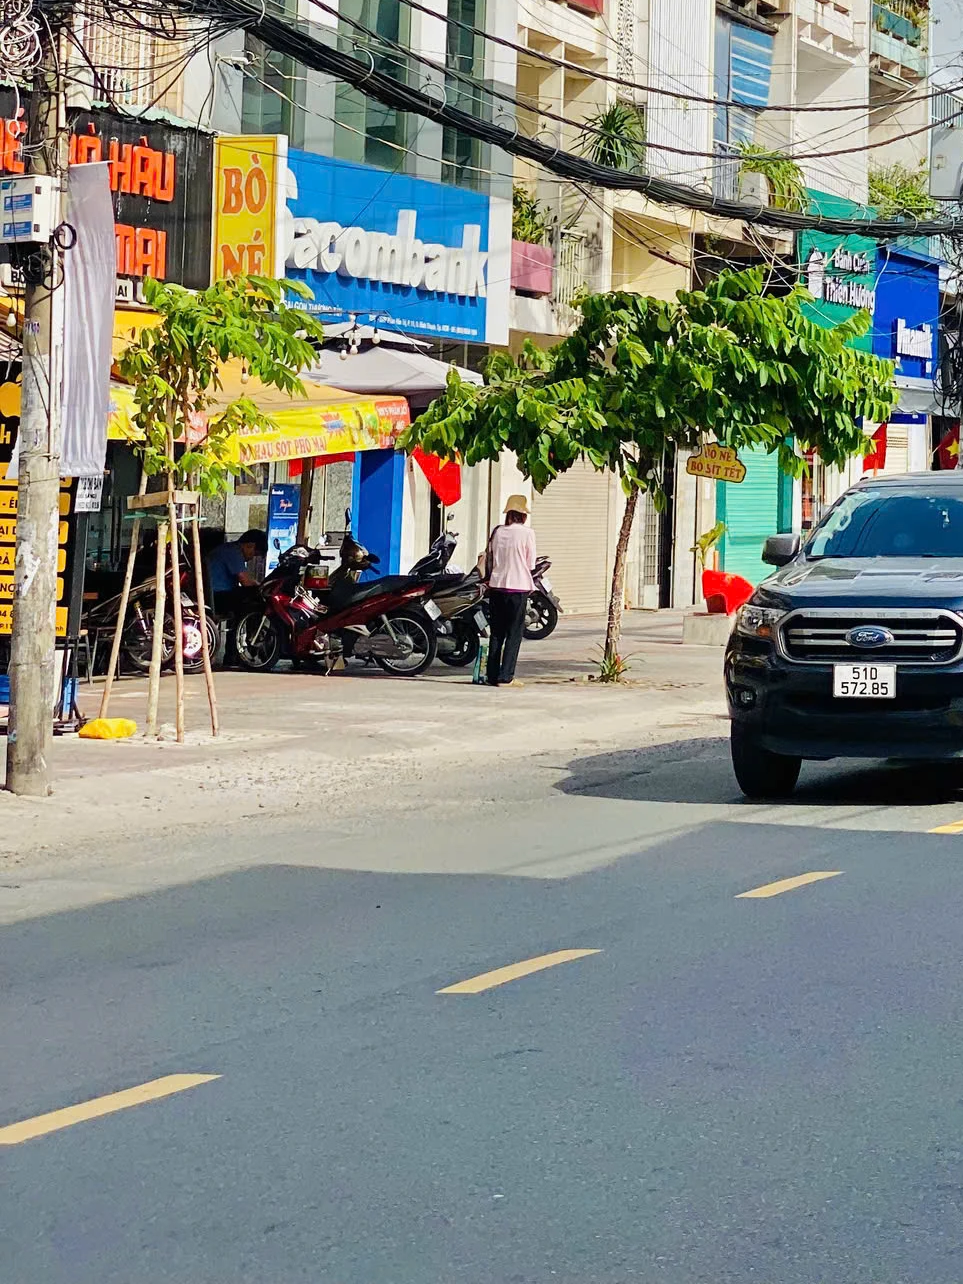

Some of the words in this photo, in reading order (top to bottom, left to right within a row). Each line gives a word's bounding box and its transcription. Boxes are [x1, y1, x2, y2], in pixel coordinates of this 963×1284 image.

[222, 154, 267, 215] BÒ
[221, 230, 265, 288] NÉ
[855, 630, 880, 642] Ford
[852, 667, 878, 680] 51D
[841, 681, 889, 696] 572.85
